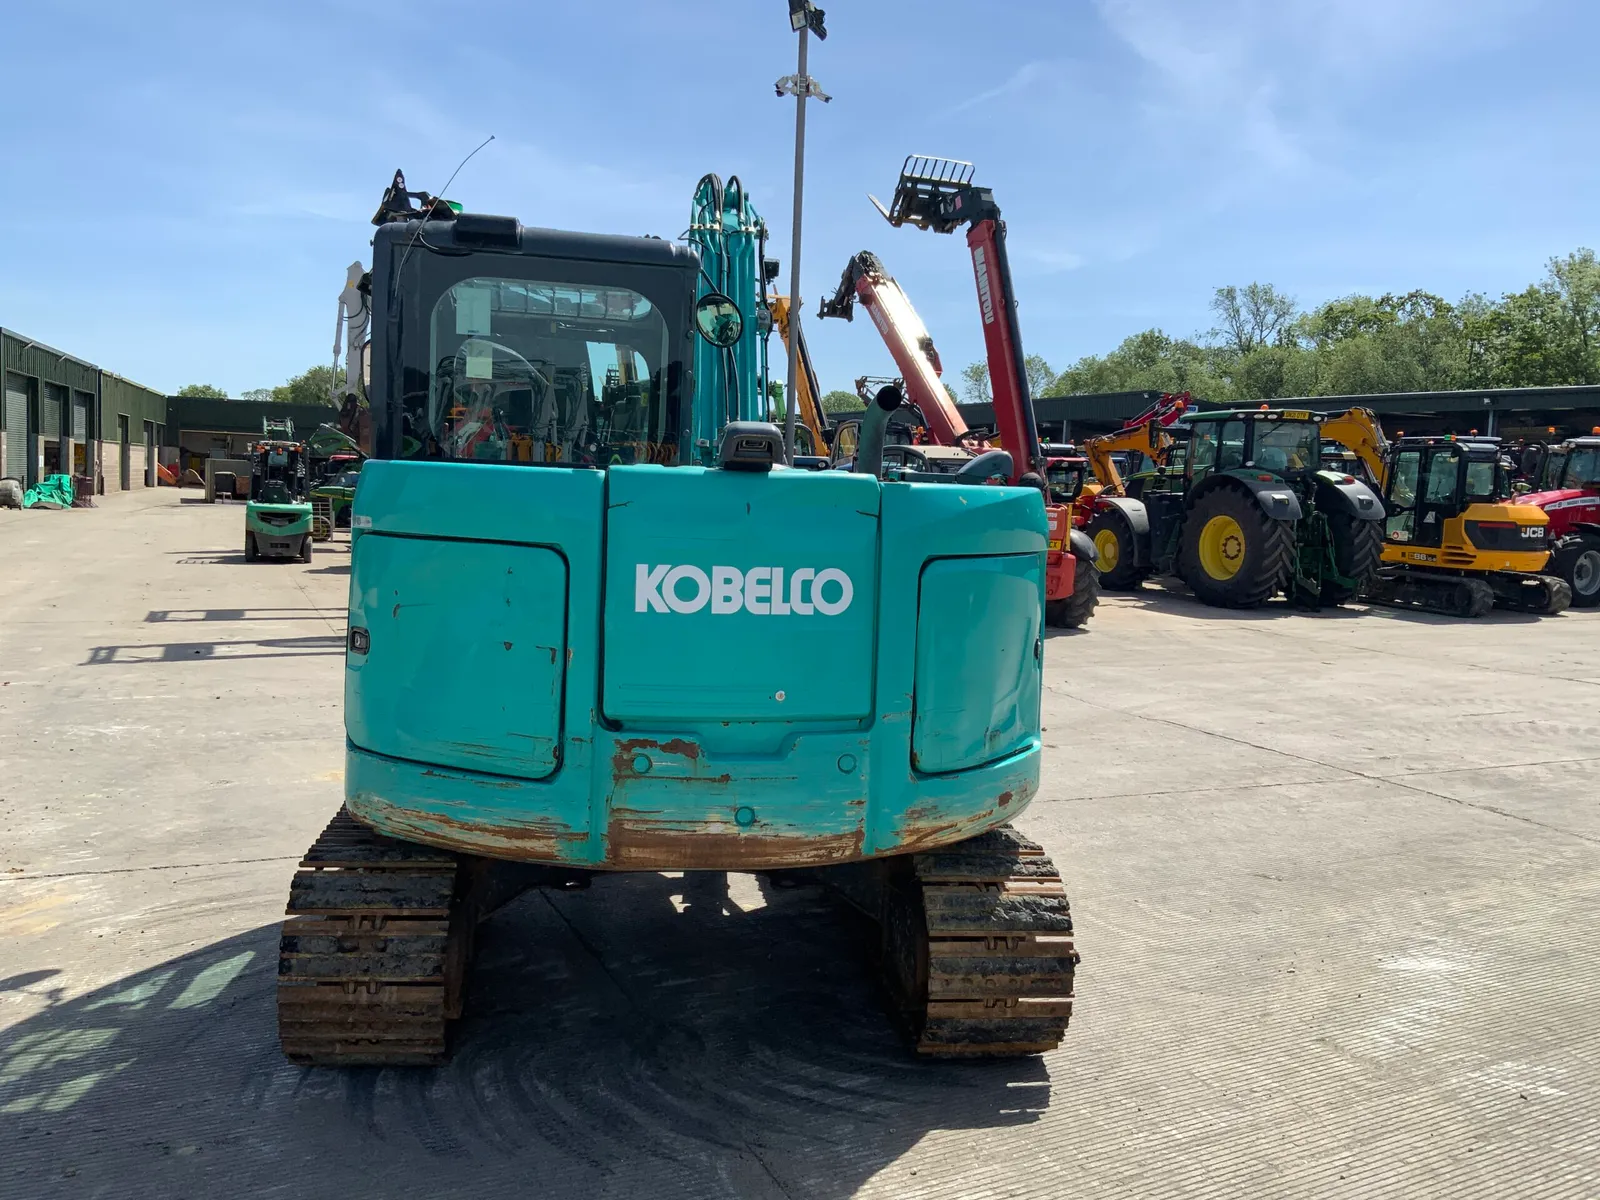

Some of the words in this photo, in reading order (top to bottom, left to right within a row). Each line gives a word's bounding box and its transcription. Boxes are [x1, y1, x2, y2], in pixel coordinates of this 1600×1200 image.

[974, 246, 994, 325] MANITOU
[1521, 527, 1544, 538] JCB
[634, 563, 854, 616] KOBELCO
